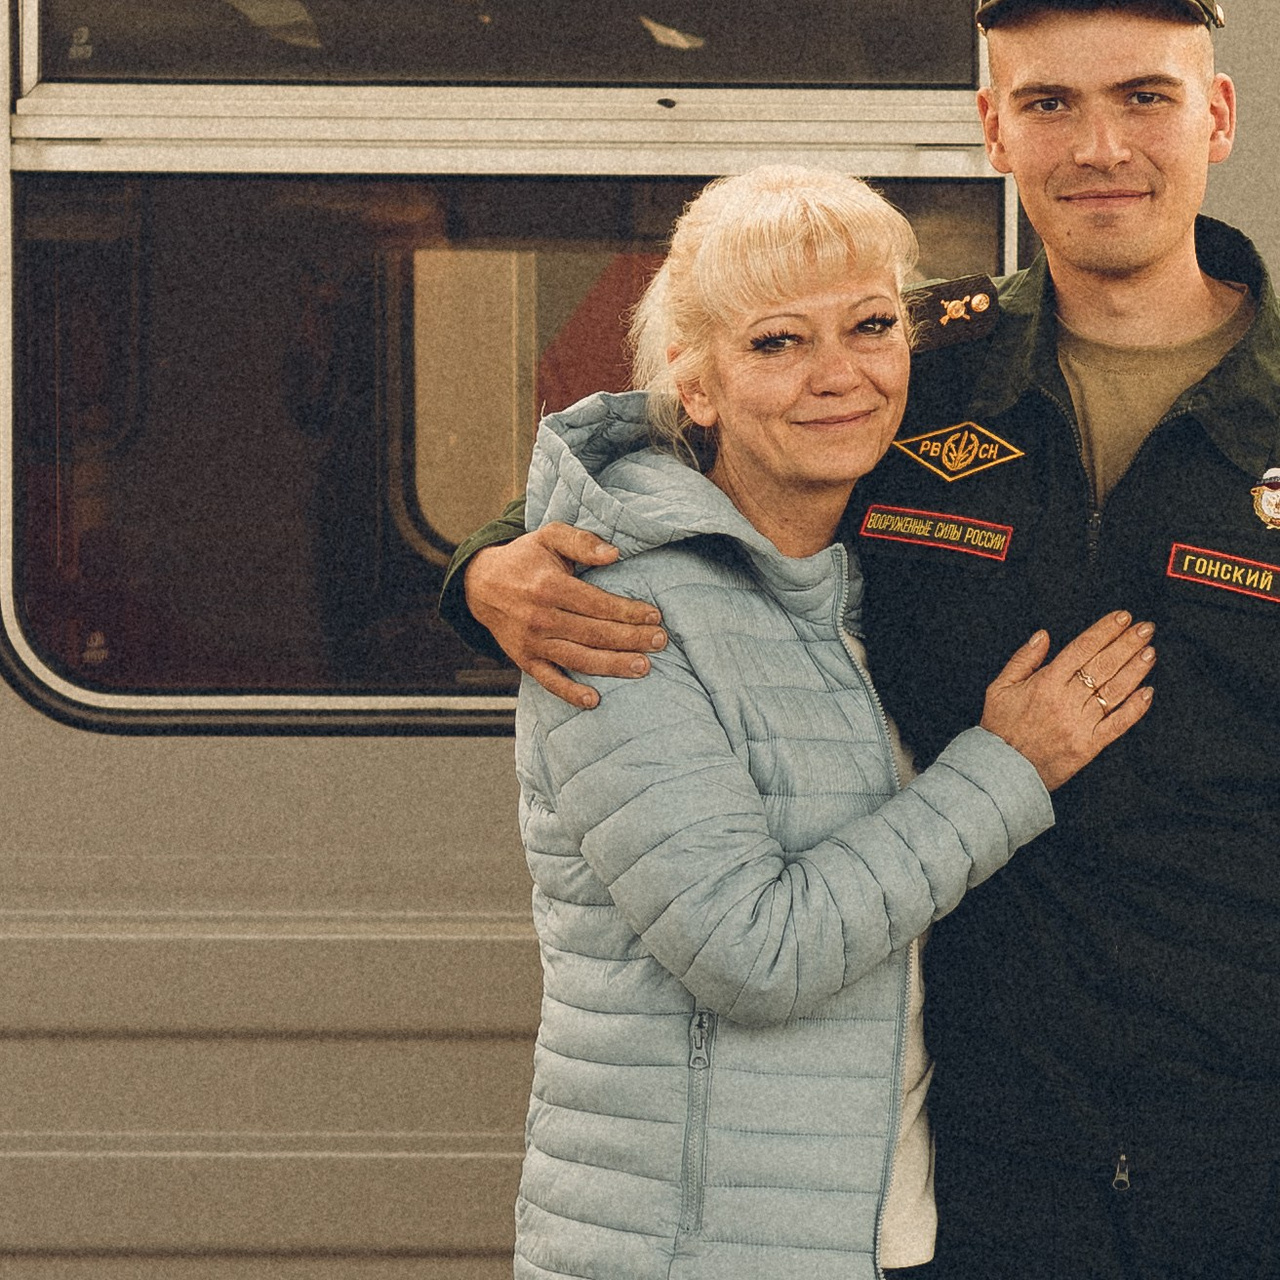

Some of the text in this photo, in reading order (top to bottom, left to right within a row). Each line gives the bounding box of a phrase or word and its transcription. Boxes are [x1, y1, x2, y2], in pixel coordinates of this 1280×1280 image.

[920, 440, 999, 459] РВ СН
[867, 513, 1006, 550] ВООРУЖЕННЫЕ СИЛЫ РОССИИ
[1183, 555, 1273, 591] ГОНСКИЙ
